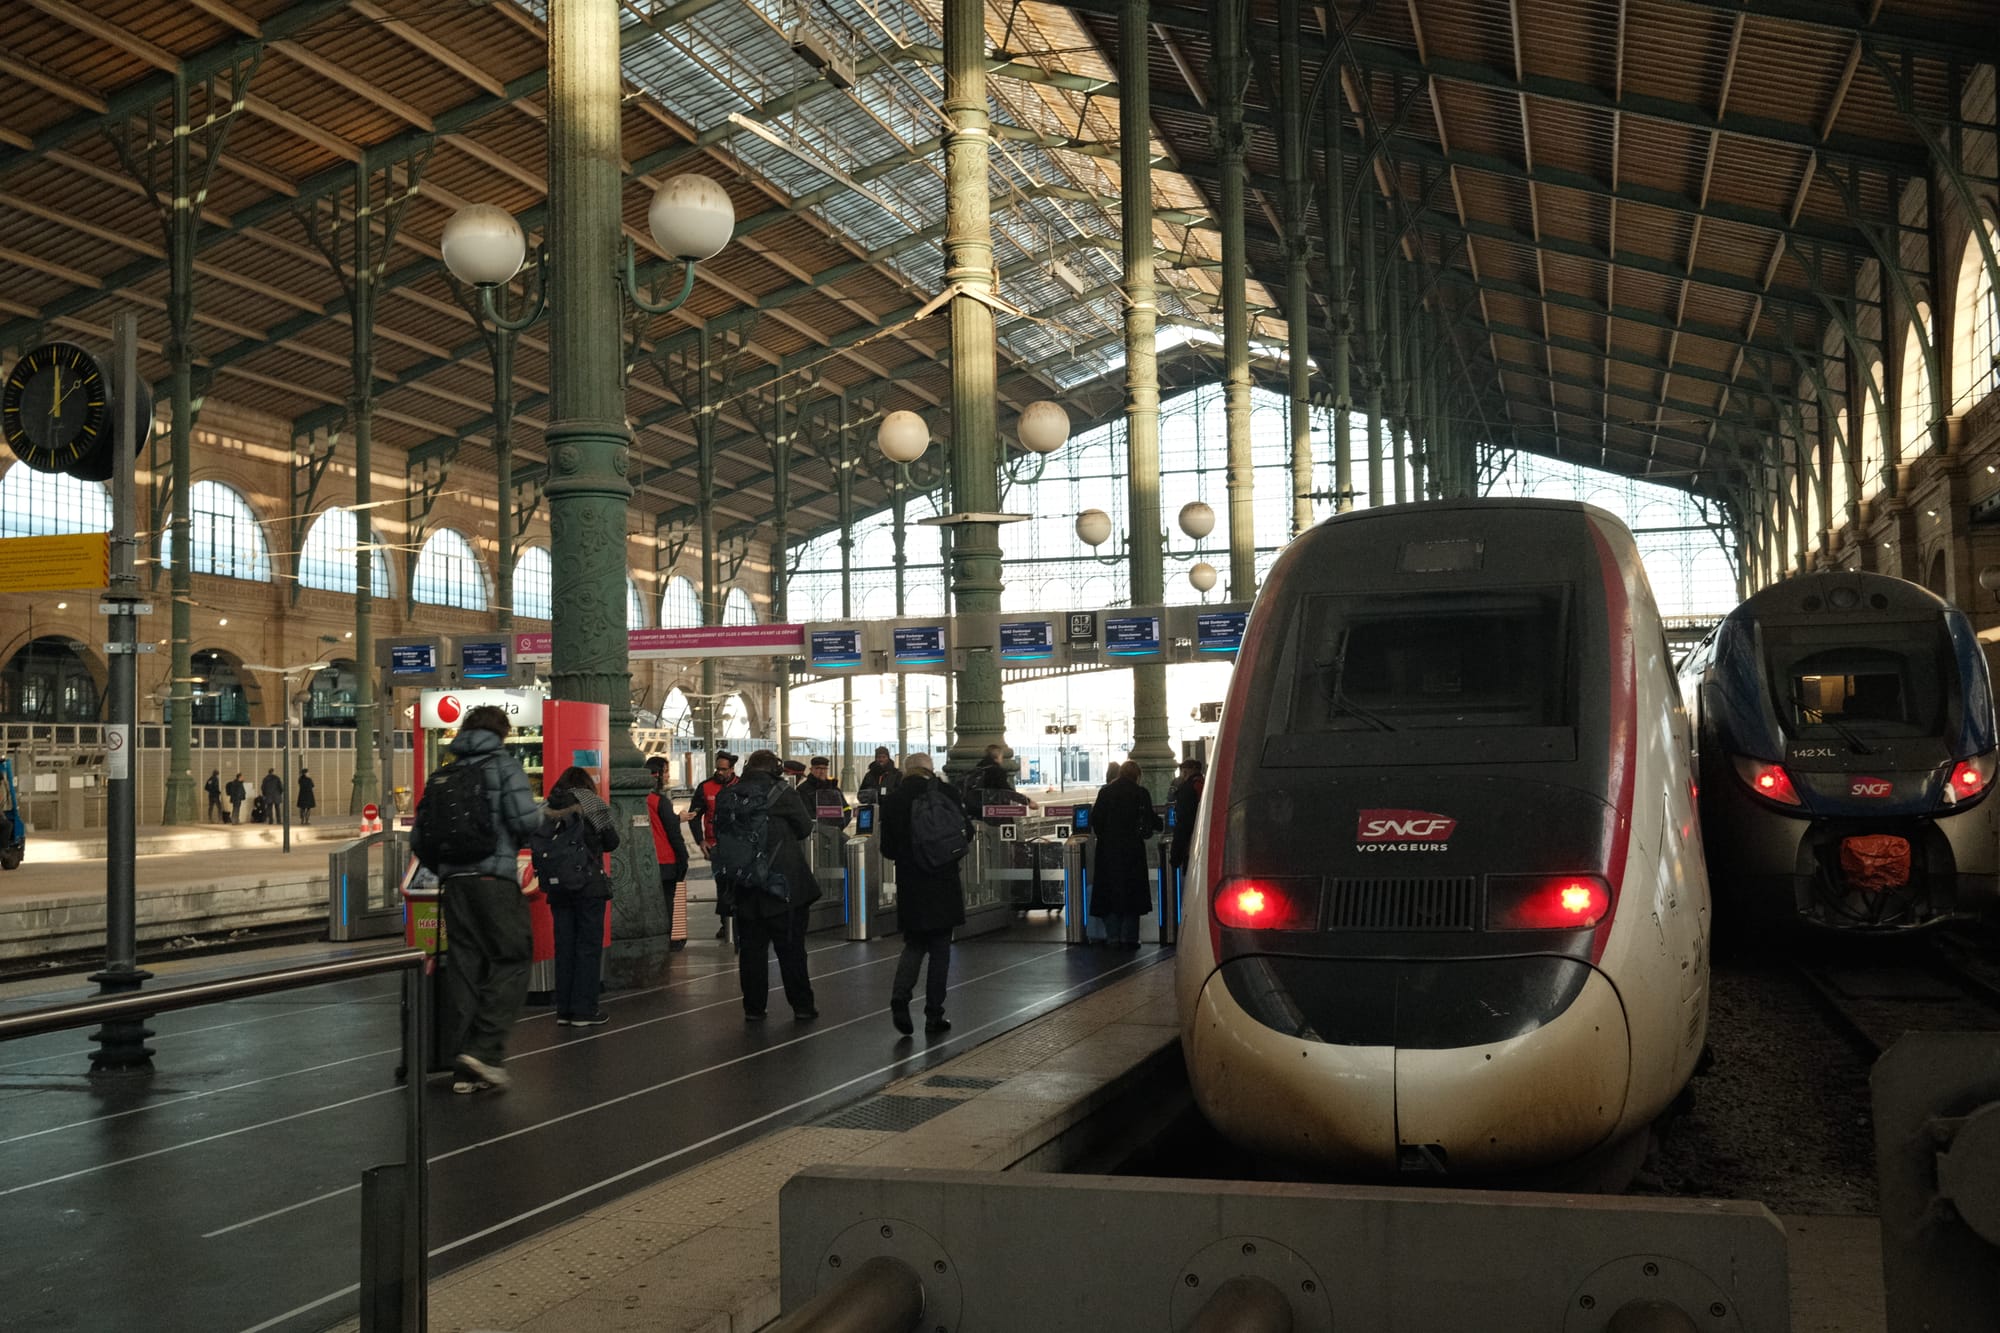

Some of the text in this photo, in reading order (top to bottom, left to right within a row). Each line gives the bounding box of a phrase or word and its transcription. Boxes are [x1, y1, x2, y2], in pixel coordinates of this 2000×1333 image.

[1793, 748, 1836, 758] 142XL
[1851, 783, 1890, 796] SNCF
[1362, 819, 1451, 837] SNCF
[1356, 843, 1448, 852] VOYAGEURS
